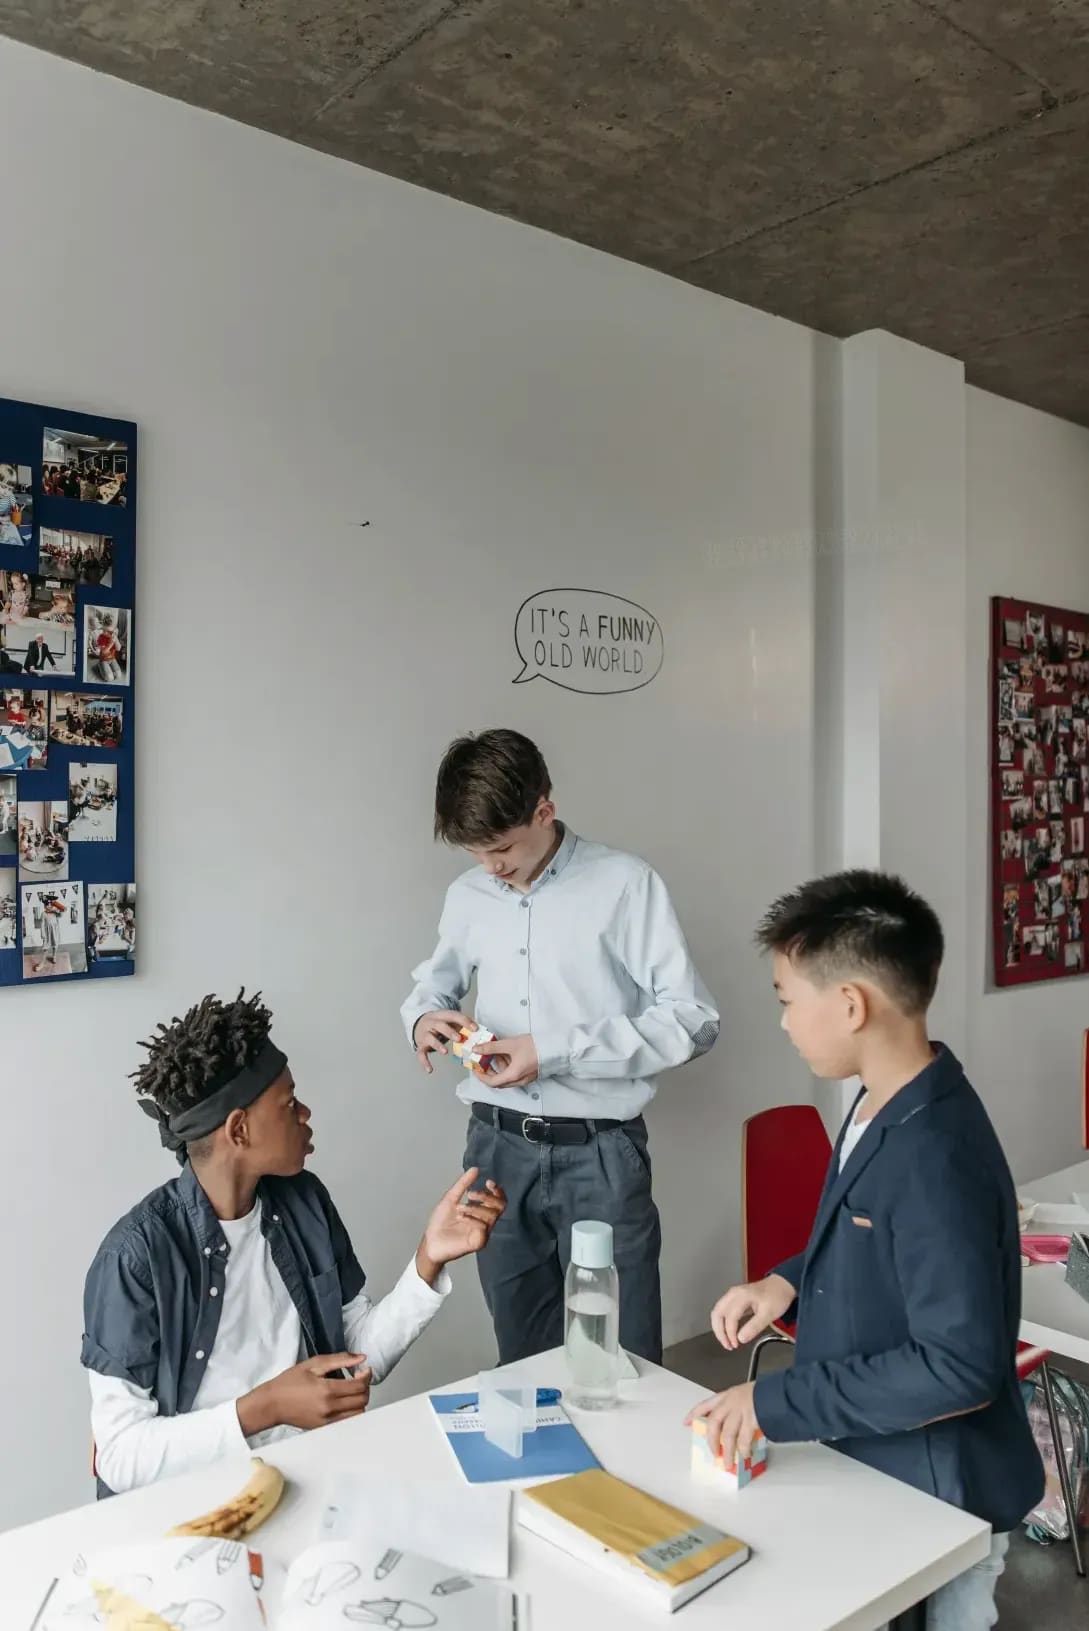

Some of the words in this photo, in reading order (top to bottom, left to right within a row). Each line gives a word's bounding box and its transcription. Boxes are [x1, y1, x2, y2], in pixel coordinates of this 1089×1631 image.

[531, 607, 570, 638] IT'S
[579, 613, 590, 638] A
[598, 615, 655, 645] FUNNY
[534, 640, 573, 668] OLD
[582, 645, 643, 674] WORLD
